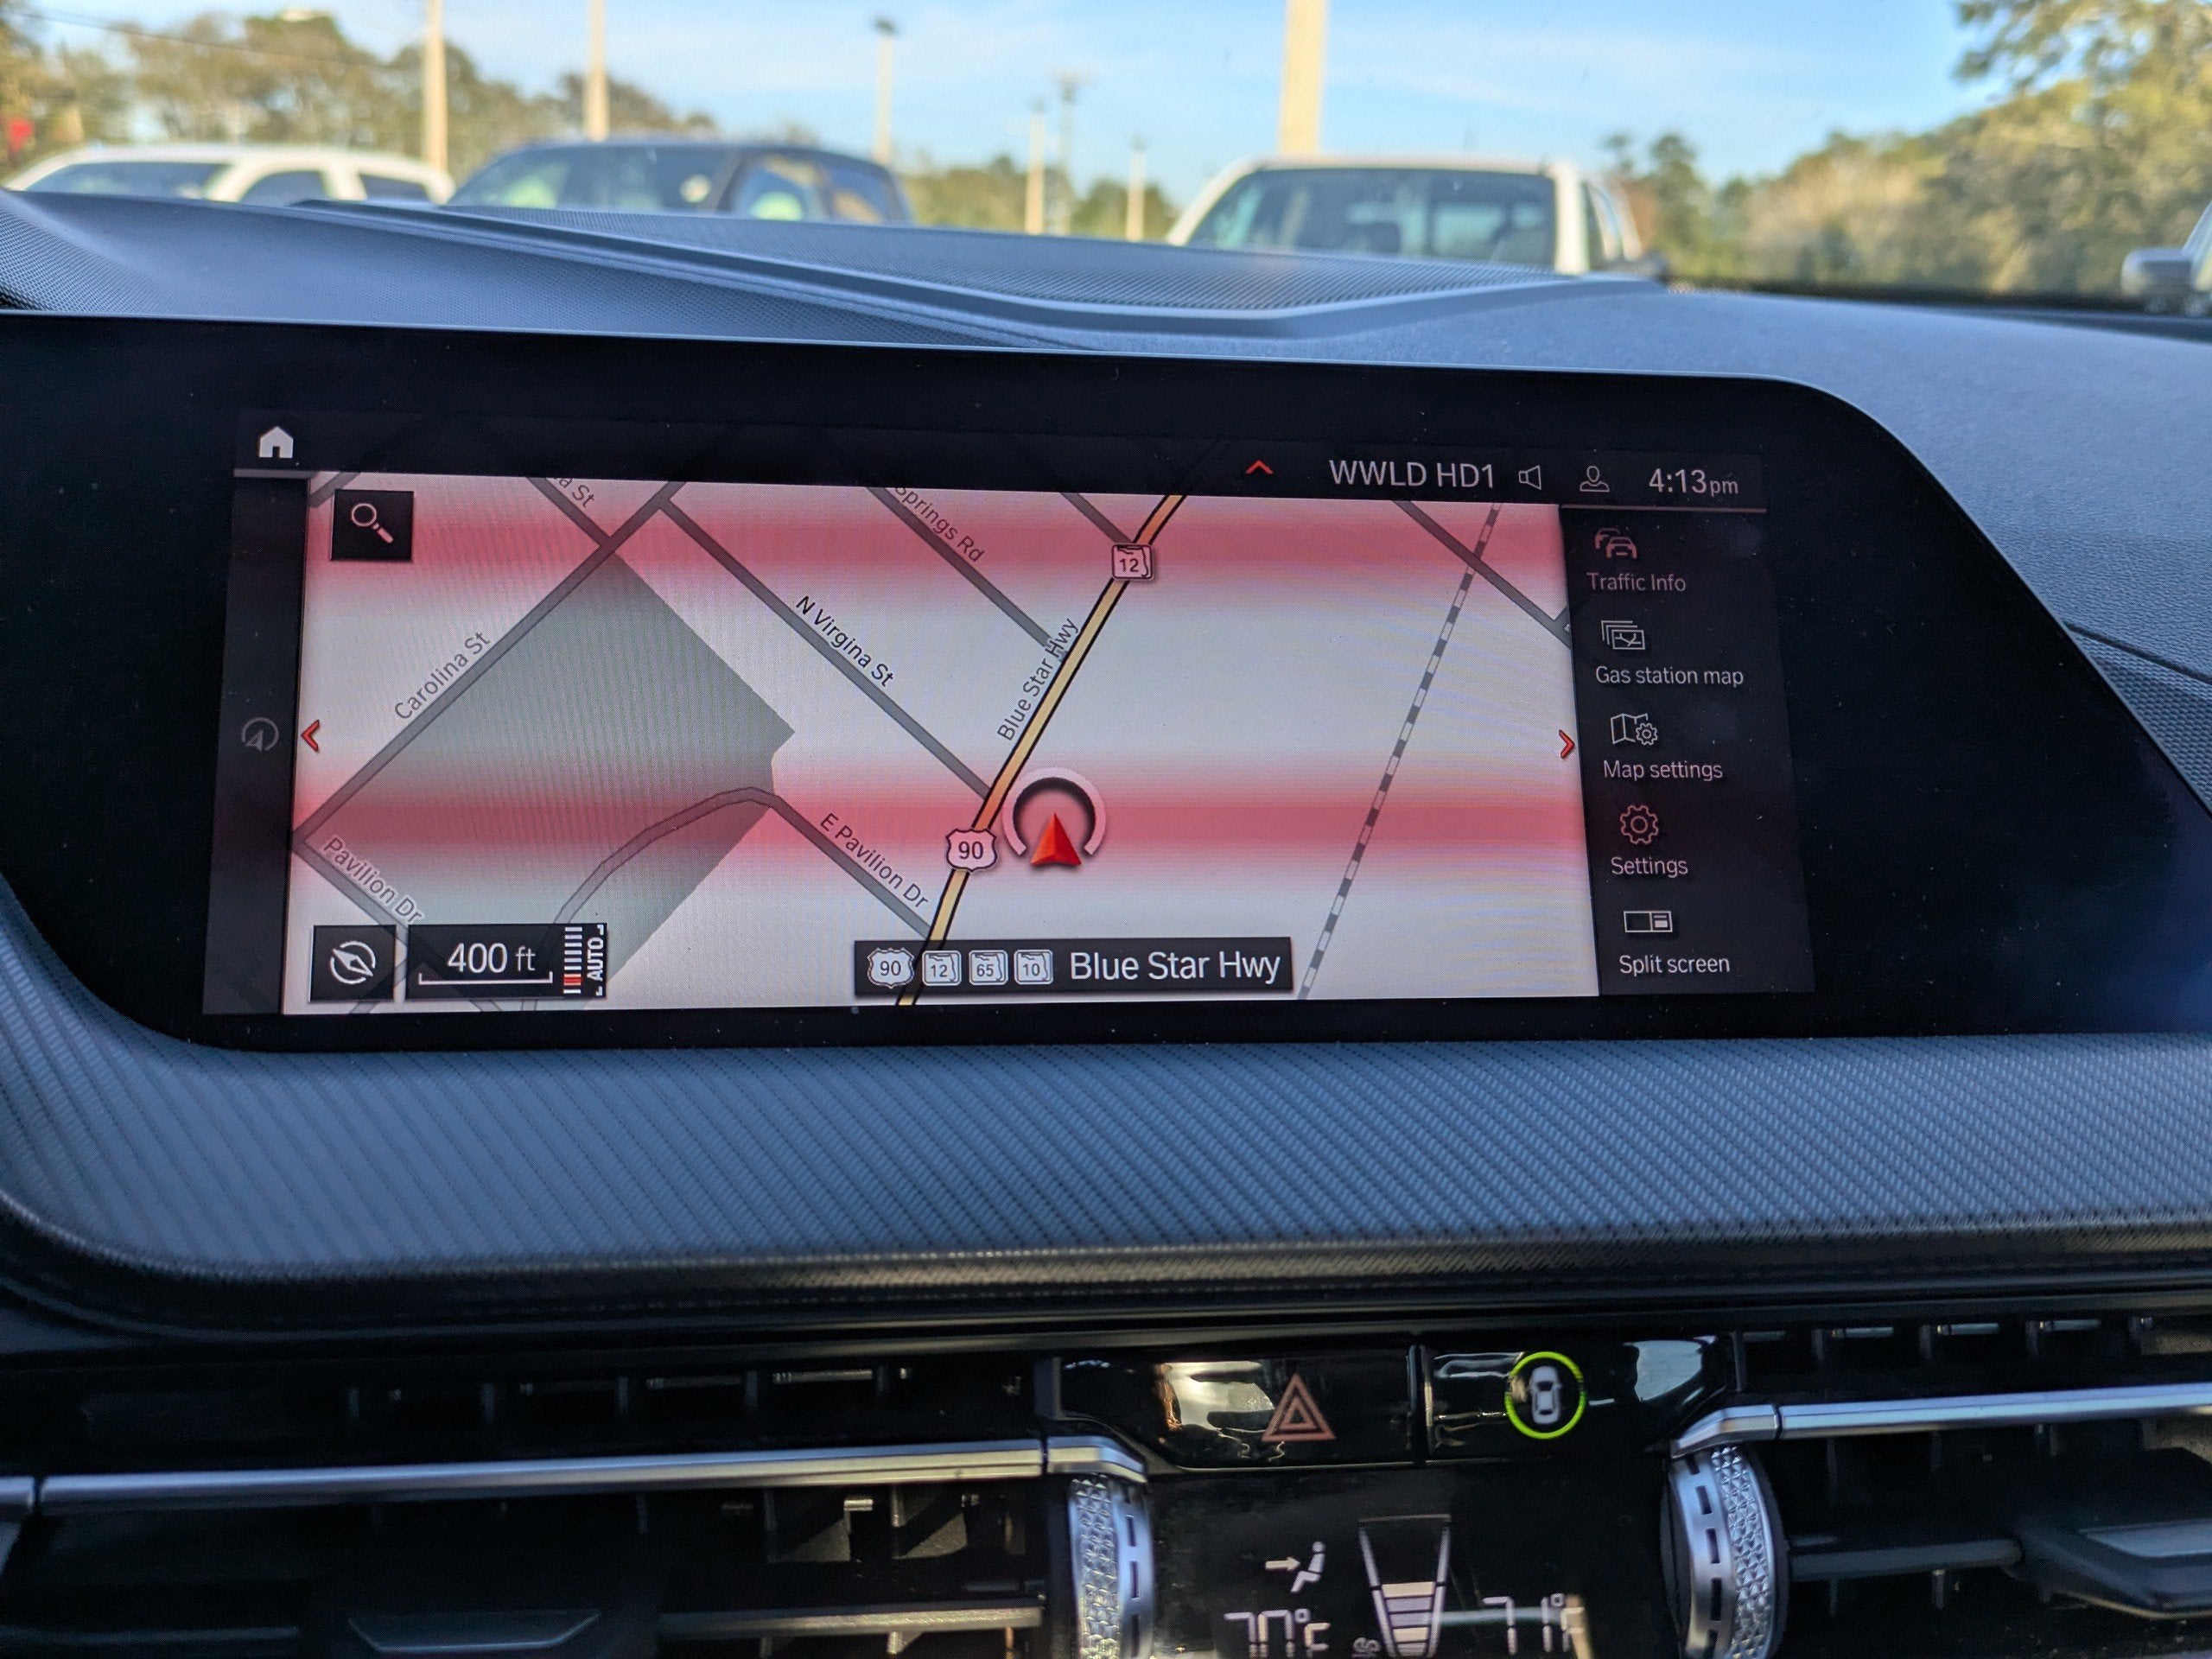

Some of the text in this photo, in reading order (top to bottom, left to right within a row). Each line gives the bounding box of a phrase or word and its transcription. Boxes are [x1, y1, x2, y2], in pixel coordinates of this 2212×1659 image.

[1329, 460, 1494, 489] WWLD HD1
[1649, 467, 1739, 498] 4:13pm
[572, 485, 594, 508] St
[957, 535, 986, 563] Rd
[1118, 557, 1140, 573] 12
[1587, 571, 1686, 593] Traffic Info
[796, 595, 894, 687] N Virgina St
[394, 632, 491, 719] Carolina St
[996, 618, 1079, 741] Blue Star Hwy
[1596, 665, 1744, 688] Gas station map
[1604, 760, 1724, 781] Map settings
[820, 812, 929, 908] E Pavilion Dr
[958, 841, 984, 860] 90
[323, 837, 423, 922] Pavilion Dr
[1611, 856, 1688, 879] Settings
[447, 943, 536, 974] 400 ft
[587, 937, 604, 982] AUTO
[880, 950, 1281, 985] 90 12 65 10 Blue Star Hwy
[1618, 954, 1731, 976] Split screen
